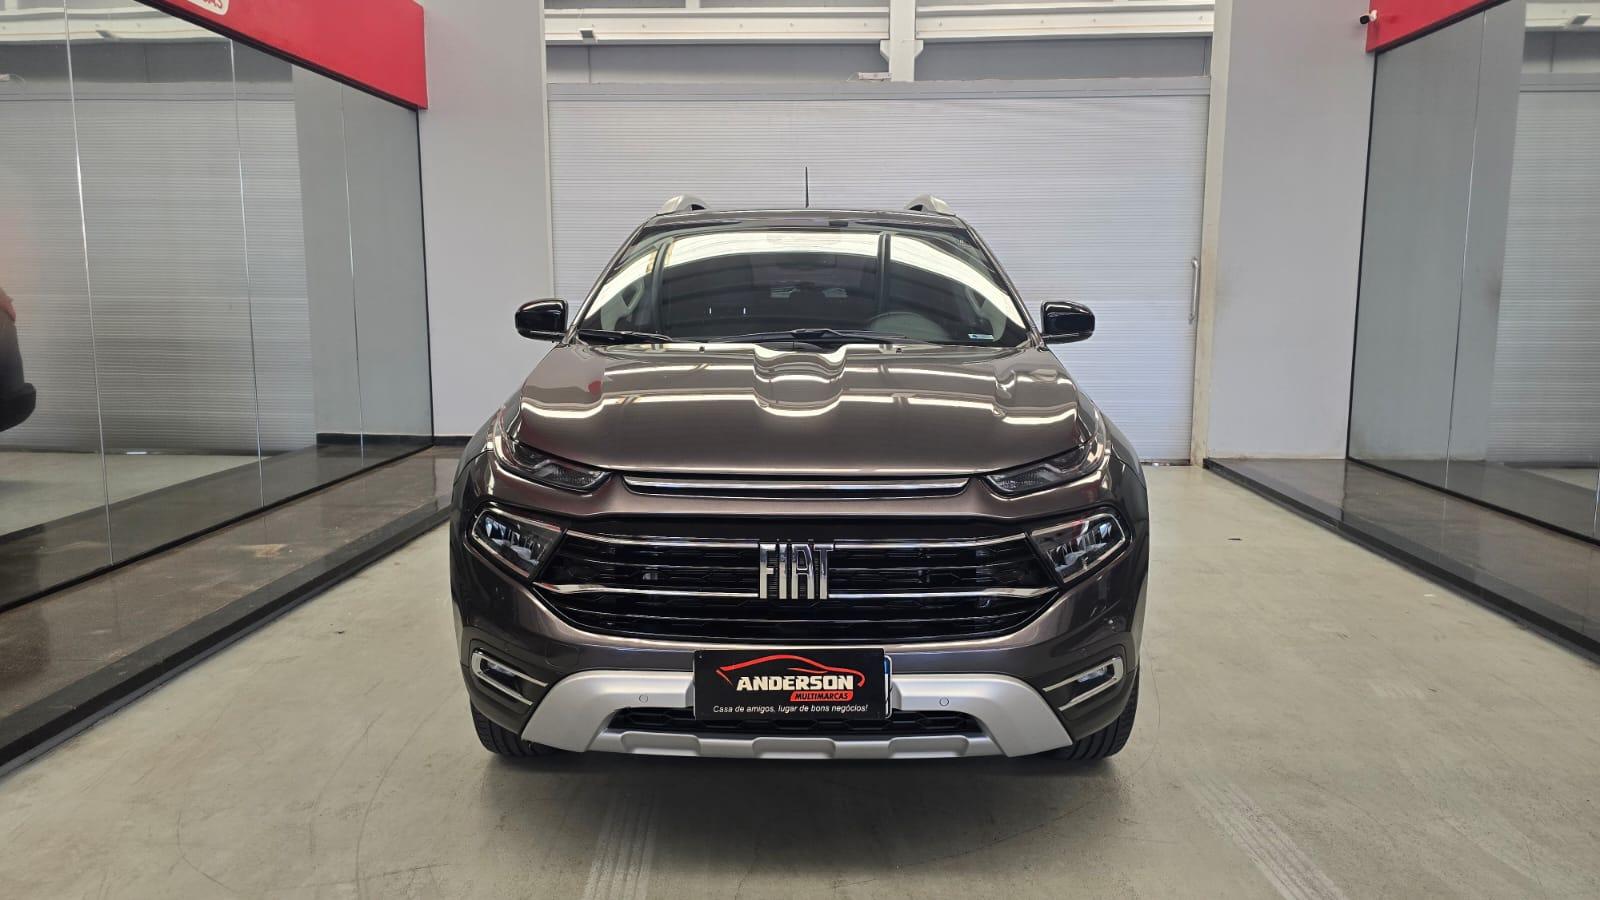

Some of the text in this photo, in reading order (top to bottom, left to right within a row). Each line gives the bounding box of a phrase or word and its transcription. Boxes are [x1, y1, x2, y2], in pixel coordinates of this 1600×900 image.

[760, 544, 834, 599] FIAT
[736, 675, 854, 691] ANDERSON
[795, 692, 849, 700] MULTIMARCAS
[713, 705, 733, 713] Casa
[734, 705, 745, 713] de
[778, 704, 798, 714] lugar
[799, 704, 809, 712] de
[810, 704, 830, 712] bons
[831, 704, 869, 714] negócios!
